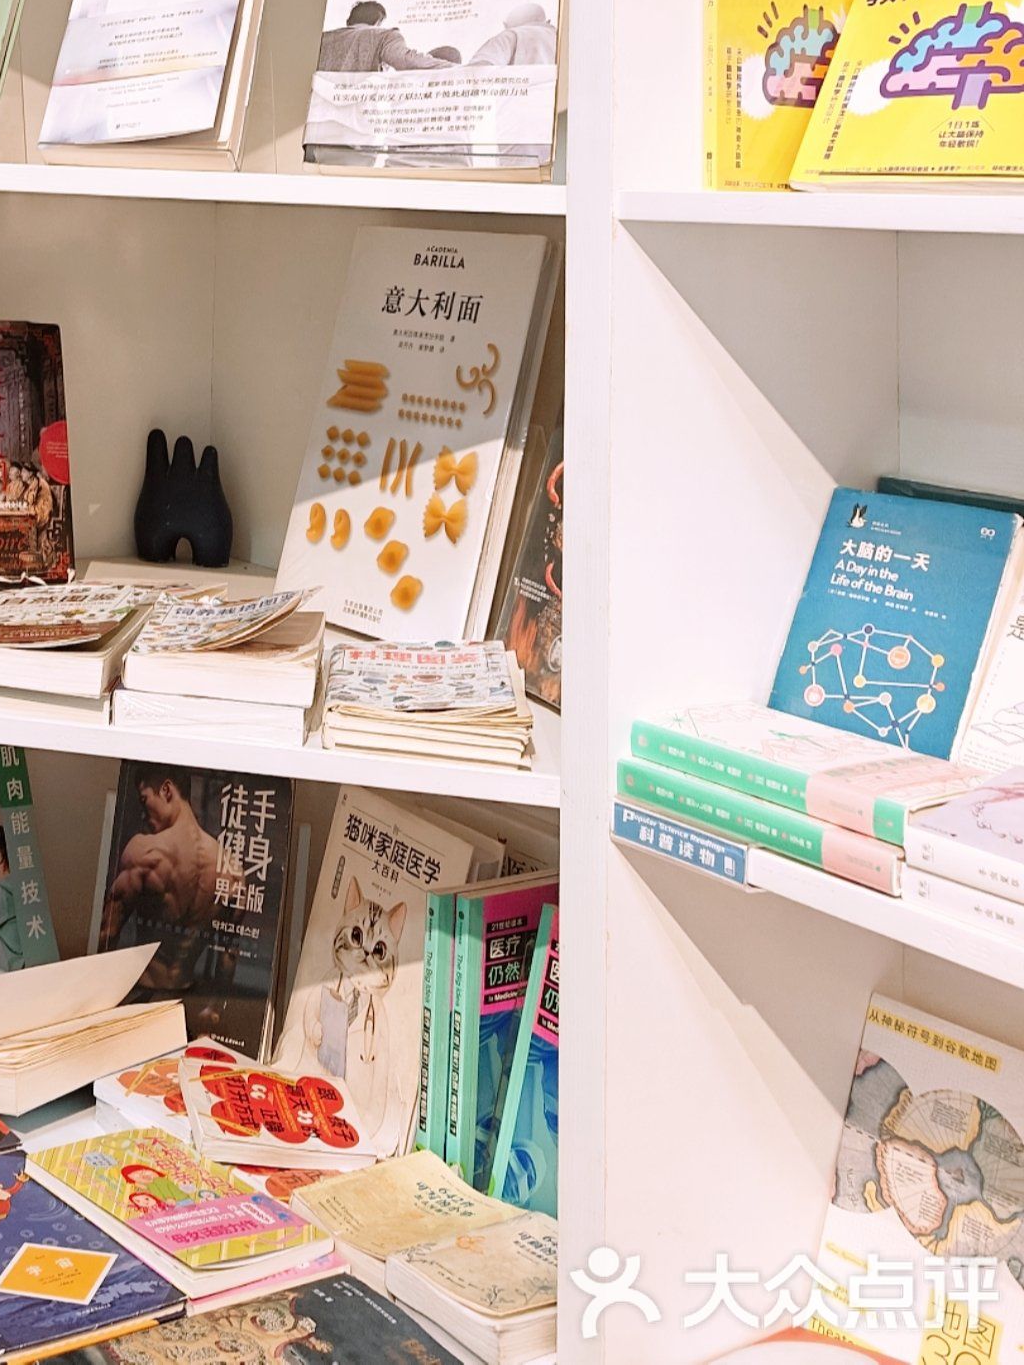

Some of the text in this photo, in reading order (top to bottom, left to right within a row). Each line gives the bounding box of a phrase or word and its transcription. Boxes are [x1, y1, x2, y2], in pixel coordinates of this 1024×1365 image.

[413, 252, 465, 270] BARILLA
[426, 245, 459, 254] ACADEMIA
[380, 285, 484, 325] 意大利面
[840, 539, 931, 571] 大脑的一天
[835, 560, 899, 582] A Day in the
[830, 573, 914, 602] Life of the Brain
[220, 784, 277, 833] 徒手
[622, 808, 658, 828] Popular
[659, 822, 688, 838] Science
[0, 745, 47, 940] 肌肉能量技术
[216, 830, 274, 882] 健身
[344, 813, 442, 886] 猫咪家庭医学
[639, 825, 715, 868] 科普读物
[371, 860, 400, 885] 大百科
[214, 878, 265, 915] 男生版
[488, 936, 522, 960] 医疗
[487, 960, 521, 985] 仍然
[494, 991, 518, 1002] Medicine
[868, 1005, 1000, 1072] 从神秘符号到谷歌地图
